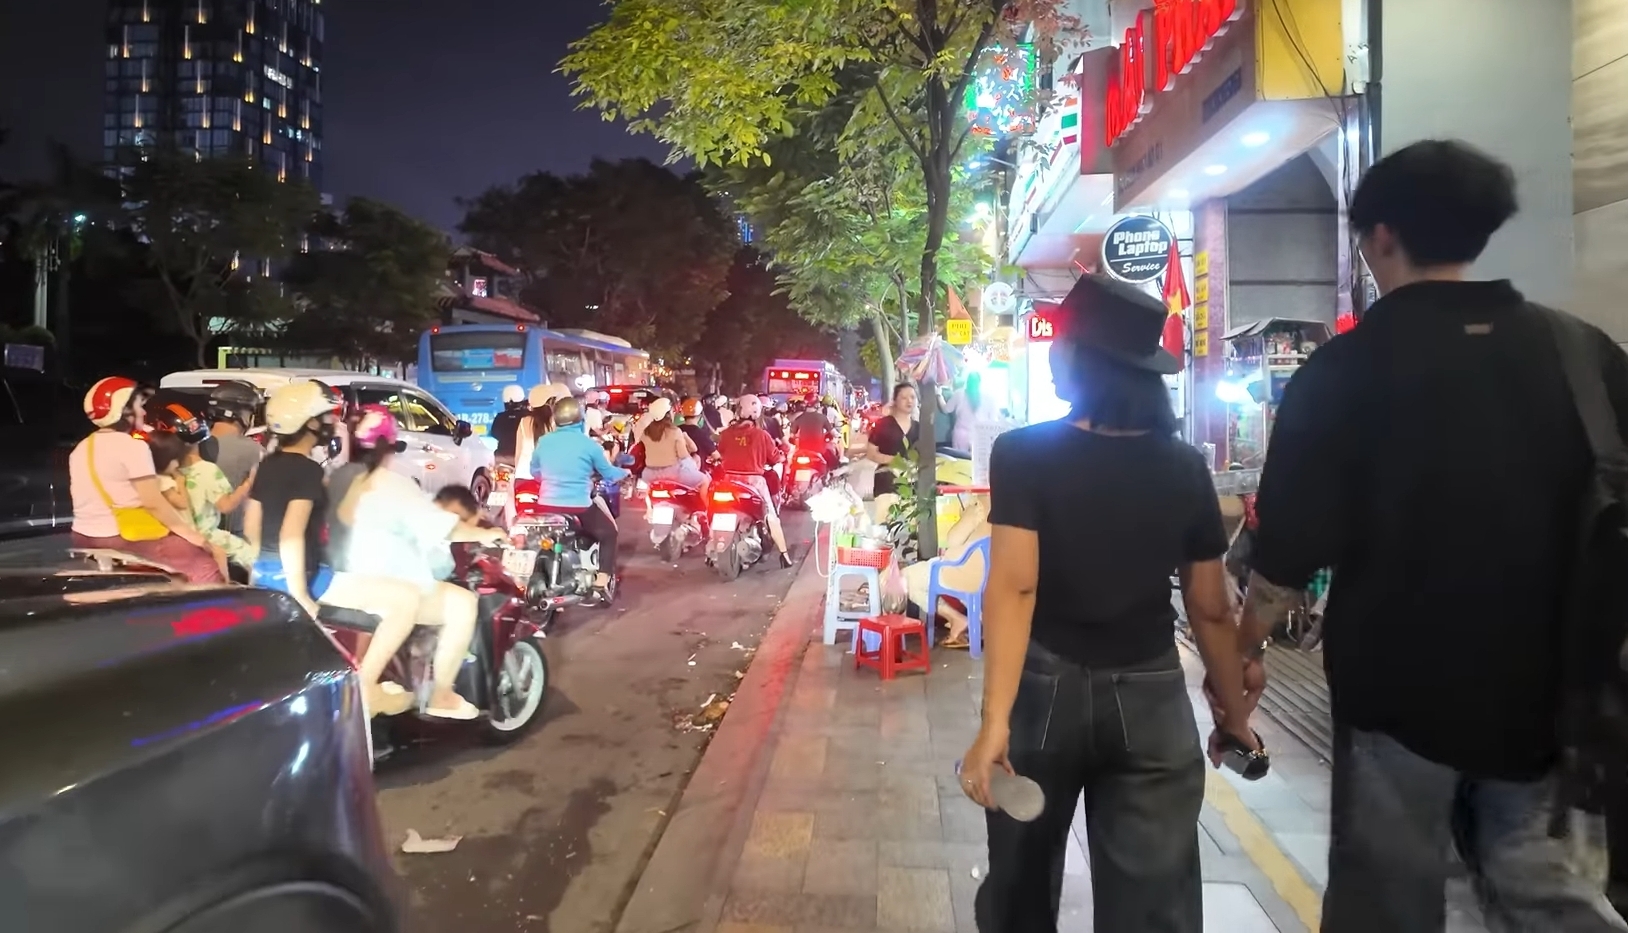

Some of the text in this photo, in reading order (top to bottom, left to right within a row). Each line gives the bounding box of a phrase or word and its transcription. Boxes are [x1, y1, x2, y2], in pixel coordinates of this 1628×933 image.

[1113, 230, 1160, 245] Phone
[1118, 240, 1168, 256] Laptop
[1121, 262, 1161, 273] Service
